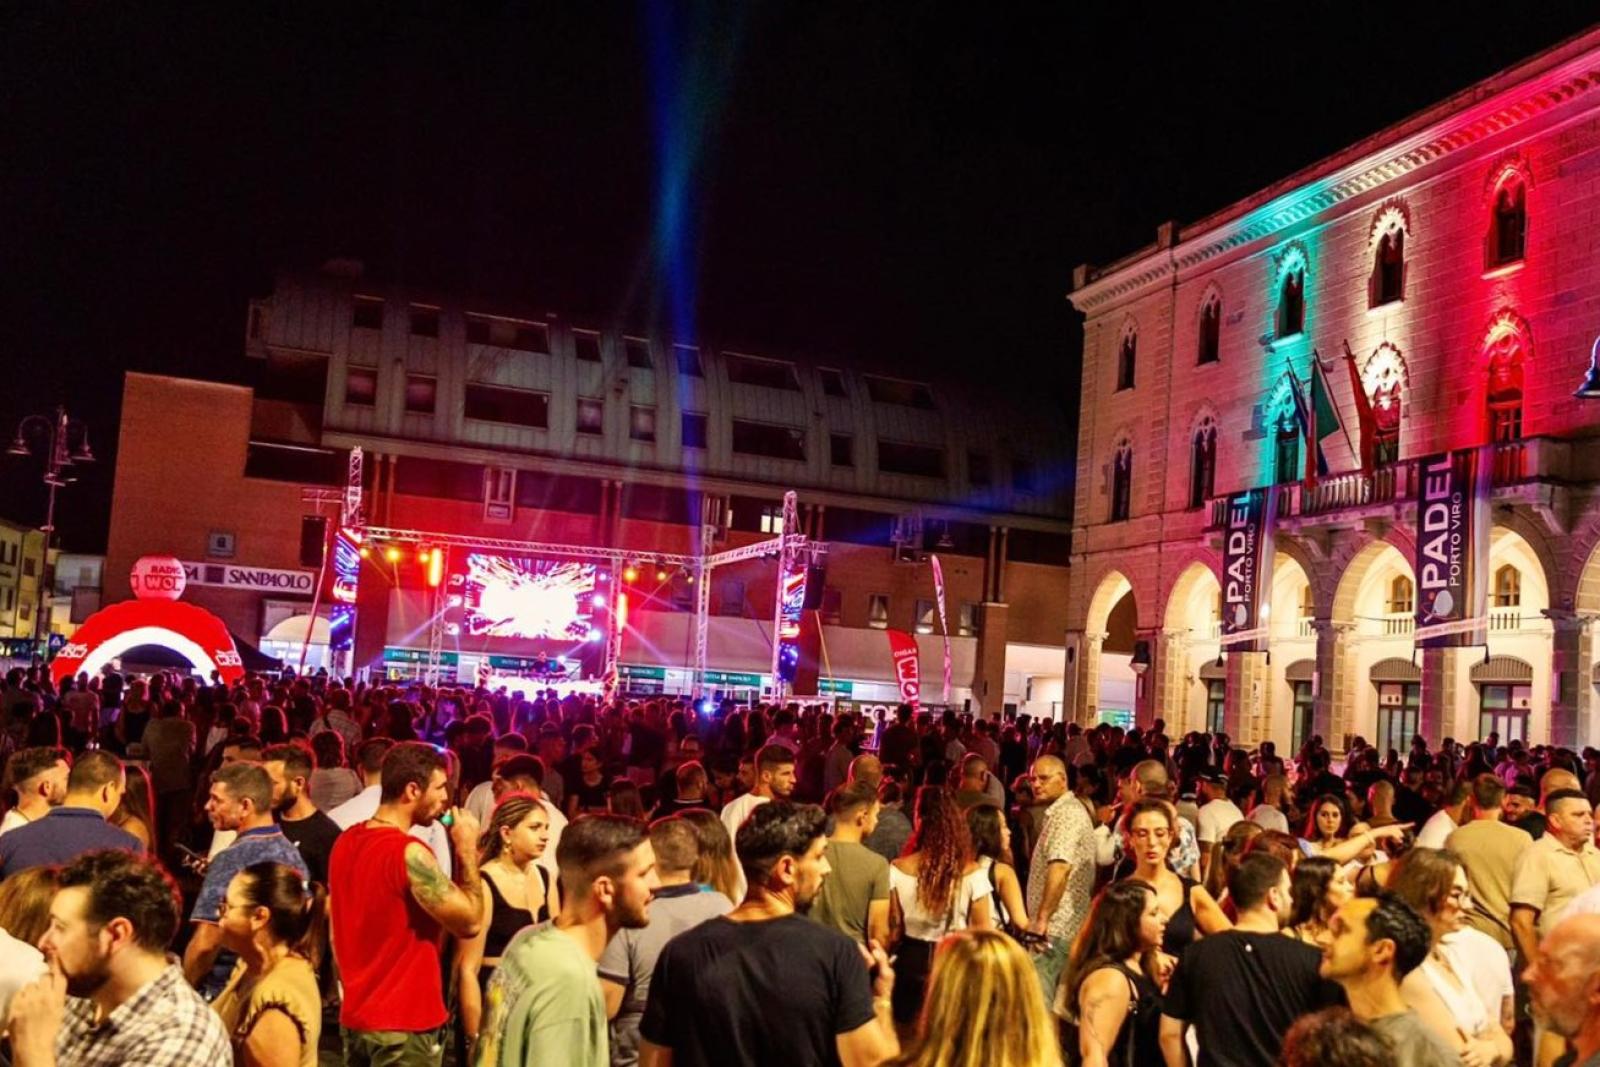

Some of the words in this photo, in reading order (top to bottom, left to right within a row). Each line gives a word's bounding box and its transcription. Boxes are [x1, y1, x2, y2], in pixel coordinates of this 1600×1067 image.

[1422, 451, 1453, 589] PADEL
[1452, 491, 1463, 530] VIRO
[1226, 491, 1250, 603] PADEL
[1247, 522, 1256, 555] VIRO
[1450, 533, 1462, 587] PORTO
[229, 568, 311, 590] SANPAOLO
[1244, 557, 1254, 602] PORTO
